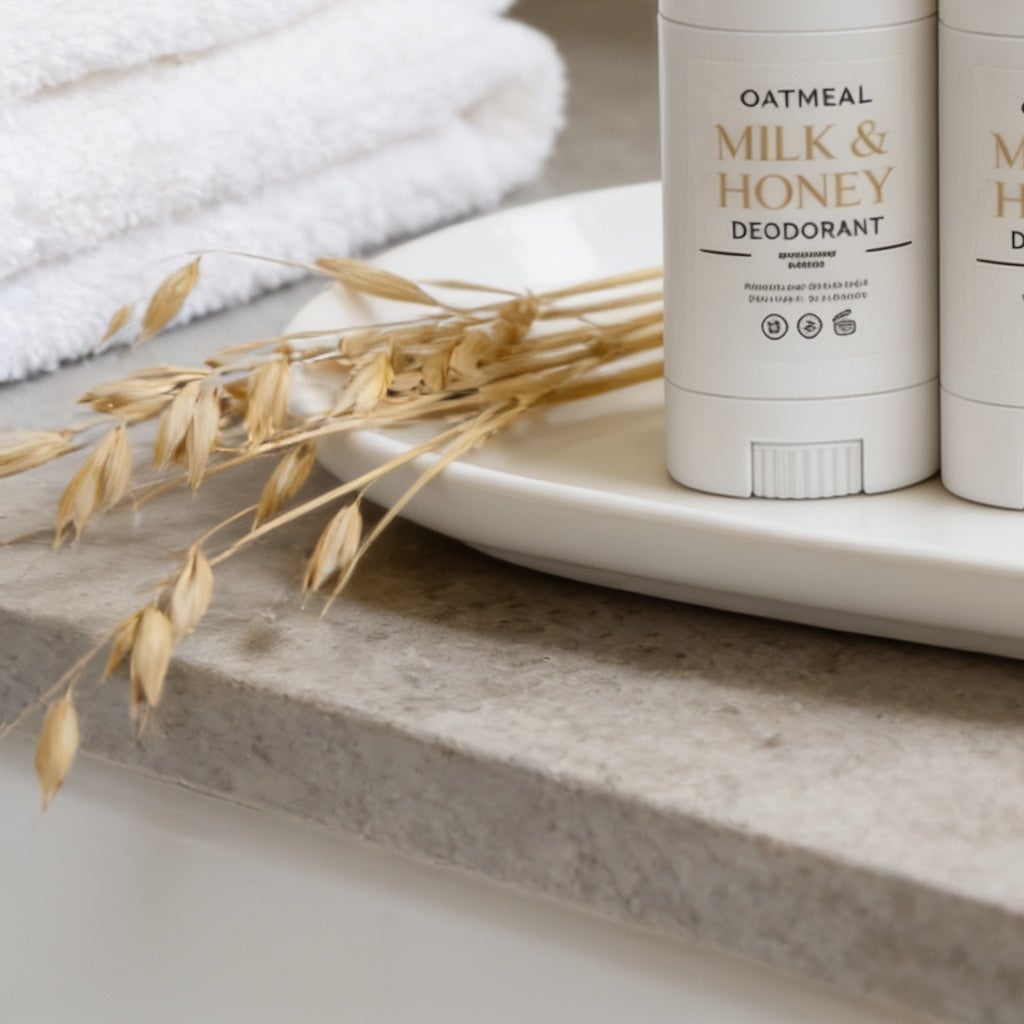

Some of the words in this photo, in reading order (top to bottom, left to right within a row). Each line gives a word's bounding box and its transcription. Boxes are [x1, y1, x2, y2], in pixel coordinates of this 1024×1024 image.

[740, 86, 873, 109] OATMEAL
[715, 123, 837, 161] MILK
[850, 120, 888, 158] &
[717, 166, 895, 210] HONEY
[732, 216, 884, 240] DEODORANT
